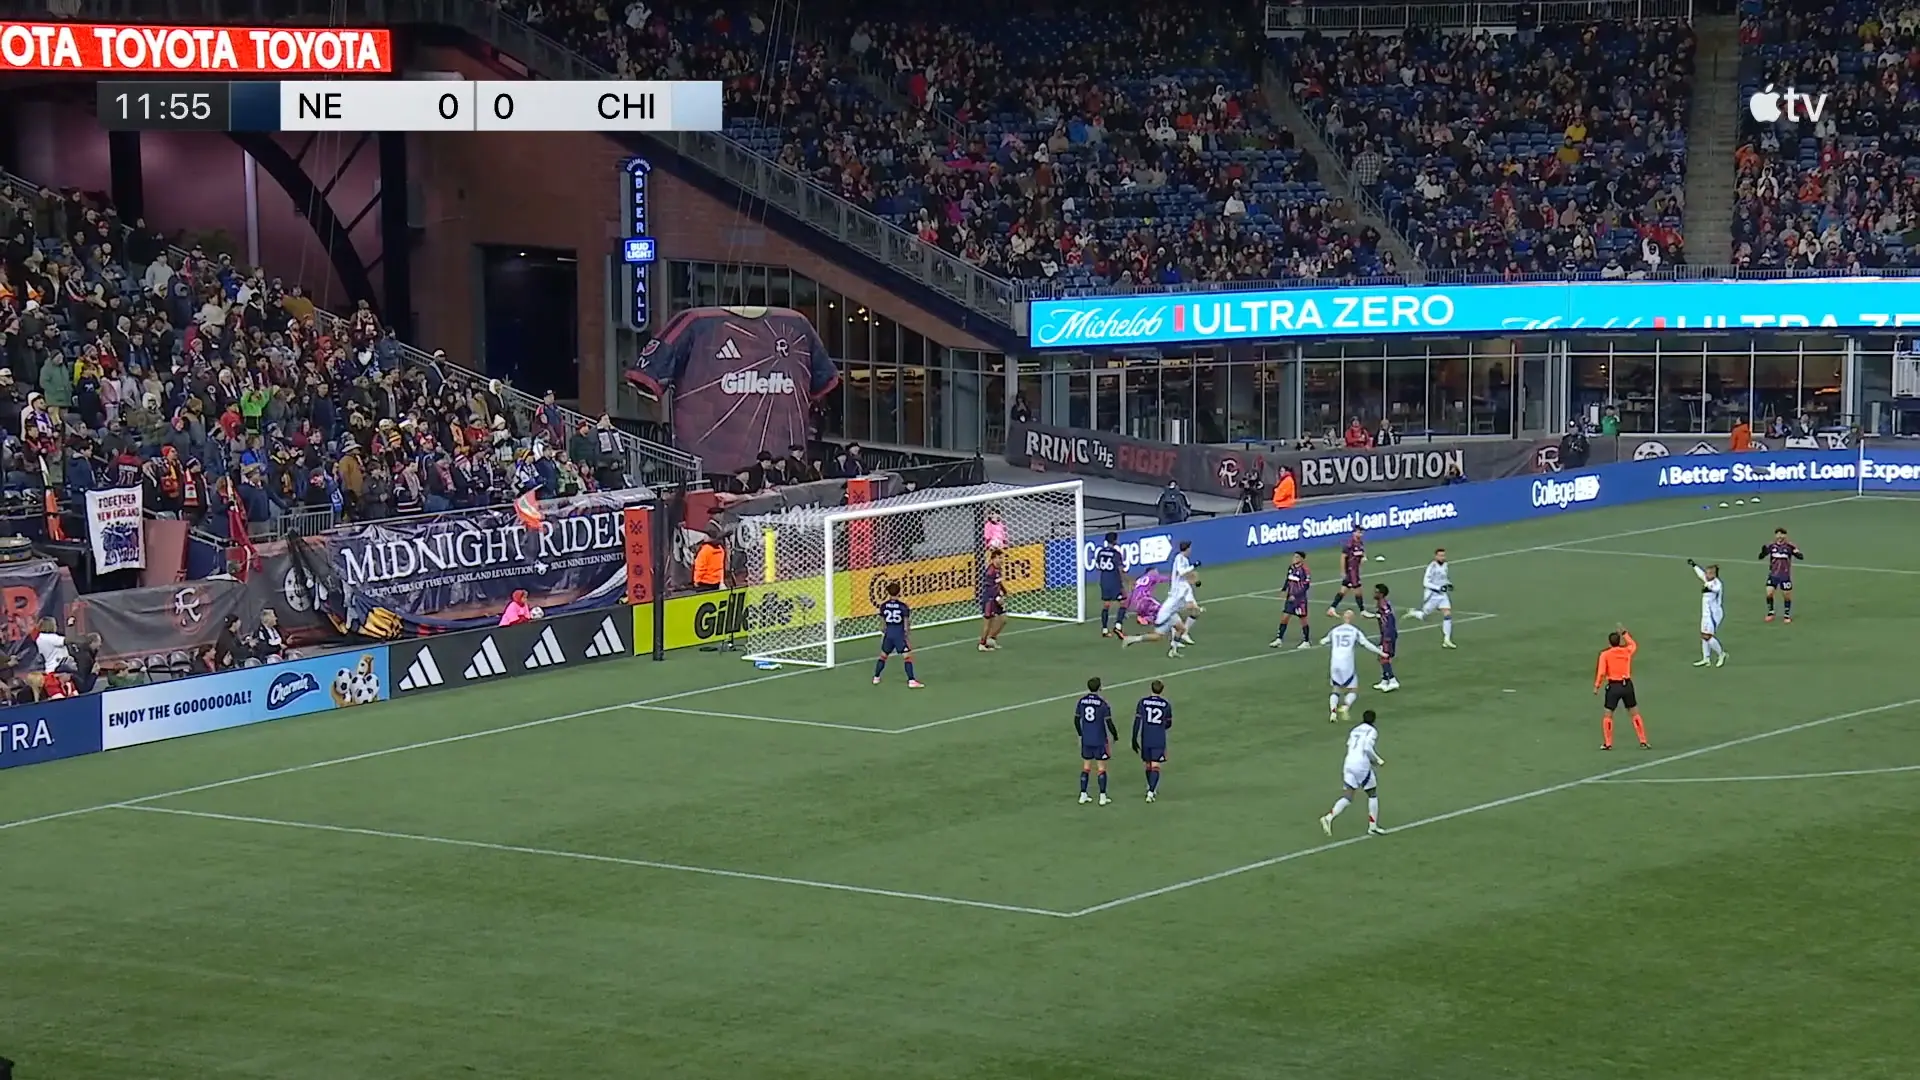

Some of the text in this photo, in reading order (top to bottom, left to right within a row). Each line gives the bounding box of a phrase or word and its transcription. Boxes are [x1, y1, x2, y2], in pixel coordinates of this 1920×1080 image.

[0, 25, 381, 69] OTA TOYOTA TOYOTA
[627, 250, 652, 259] LIGHT
[630, 242, 649, 250] BUD
[634, 177, 646, 322] BEER HALL
[1038, 295, 1454, 345] Michelob ULTRA ZERO
[720, 371, 795, 394] Gillette
[1025, 430, 1178, 477] BRING THE FIGHT
[1301, 449, 1464, 487] REVOLUTION
[1658, 468, 1668, 487] A
[1670, 466, 1729, 486] Better
[1810, 460, 1855, 480] Loan
[1862, 459, 1920, 483] Exper
[1532, 478, 1575, 508] College
[1247, 524, 1258, 547] A
[1261, 520, 1300, 546] Better
[1302, 513, 1353, 539] Student
[1389, 501, 1458, 530] Experience.
[341, 525, 527, 585] MIDNIGHT
[1099, 557, 1115, 571] 66
[491, 565, 534, 579] REVOLUTION
[1782, 581, 1792, 590] 10
[883, 609, 902, 624] 25
[1334, 634, 1351, 648] 15
[108, 690, 252, 729] ENJOY THE GOOOOOOAL!
[1084, 706, 1096, 722] 8
[1145, 706, 1164, 725] 12
[1353, 734, 1361, 750] 7
